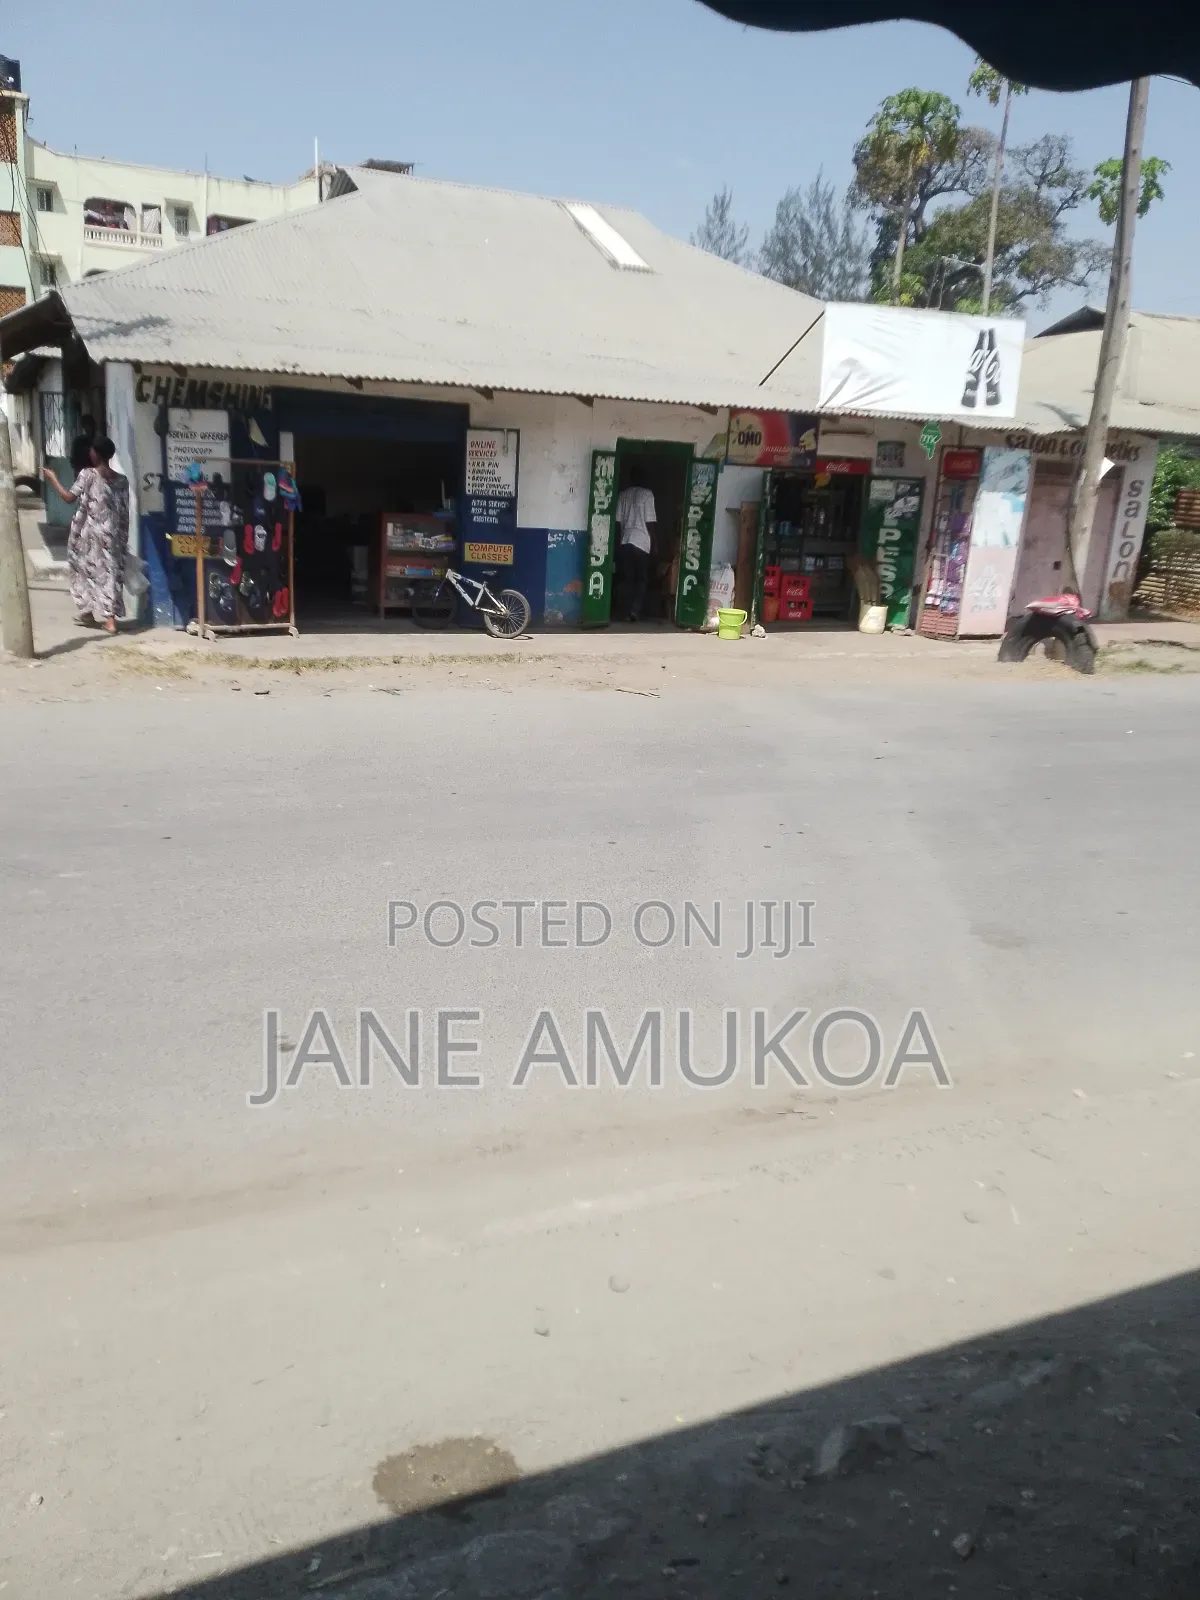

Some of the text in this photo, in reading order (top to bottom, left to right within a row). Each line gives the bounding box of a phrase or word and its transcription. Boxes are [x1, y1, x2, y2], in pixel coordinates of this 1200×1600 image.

[168, 430, 198, 439] SERVICES
[738, 431, 762, 446] OMO
[470, 440, 497, 449] ONLINE
[173, 447, 213, 456] PHOTOCOPY
[468, 449, 498, 458] SERVICES
[471, 460, 500, 469] KRA PIN
[468, 543, 513, 553] COMPUTER
[470, 551, 509, 562] CLASSES
